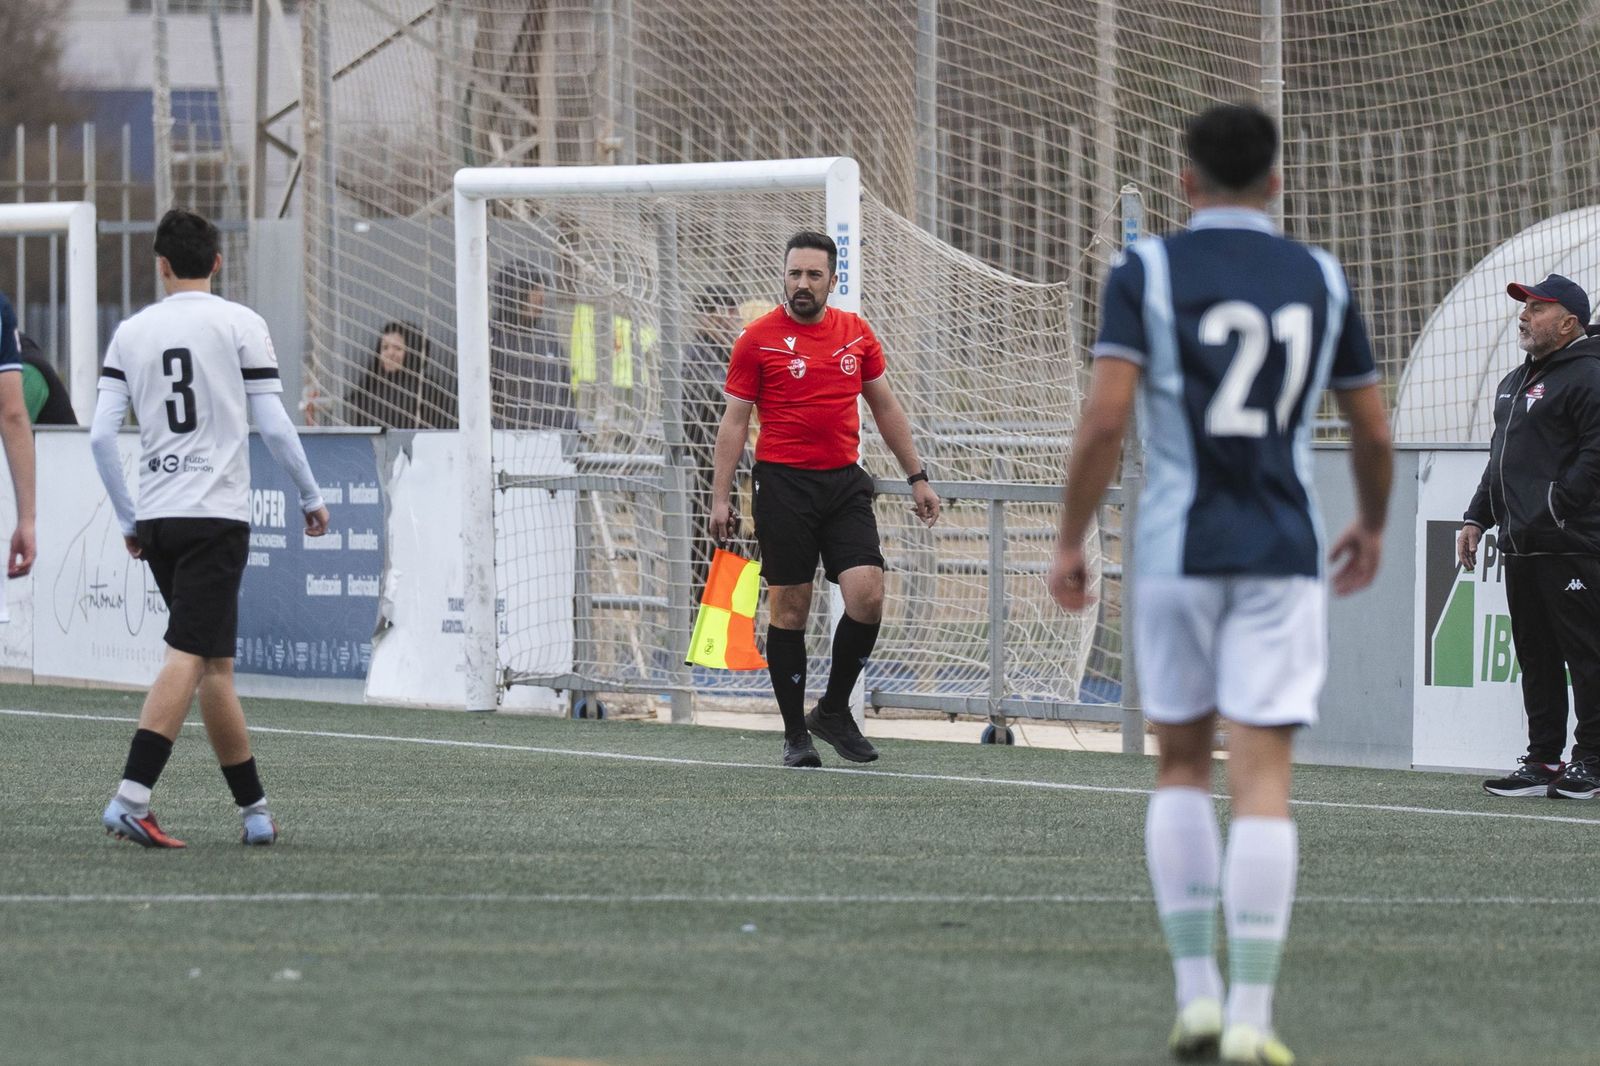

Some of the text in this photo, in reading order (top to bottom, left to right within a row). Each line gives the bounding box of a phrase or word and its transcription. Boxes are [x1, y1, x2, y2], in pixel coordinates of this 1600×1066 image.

[837, 236, 849, 295] MONDO
[162, 347, 197, 434] 3
[1199, 300, 1312, 437] 21
